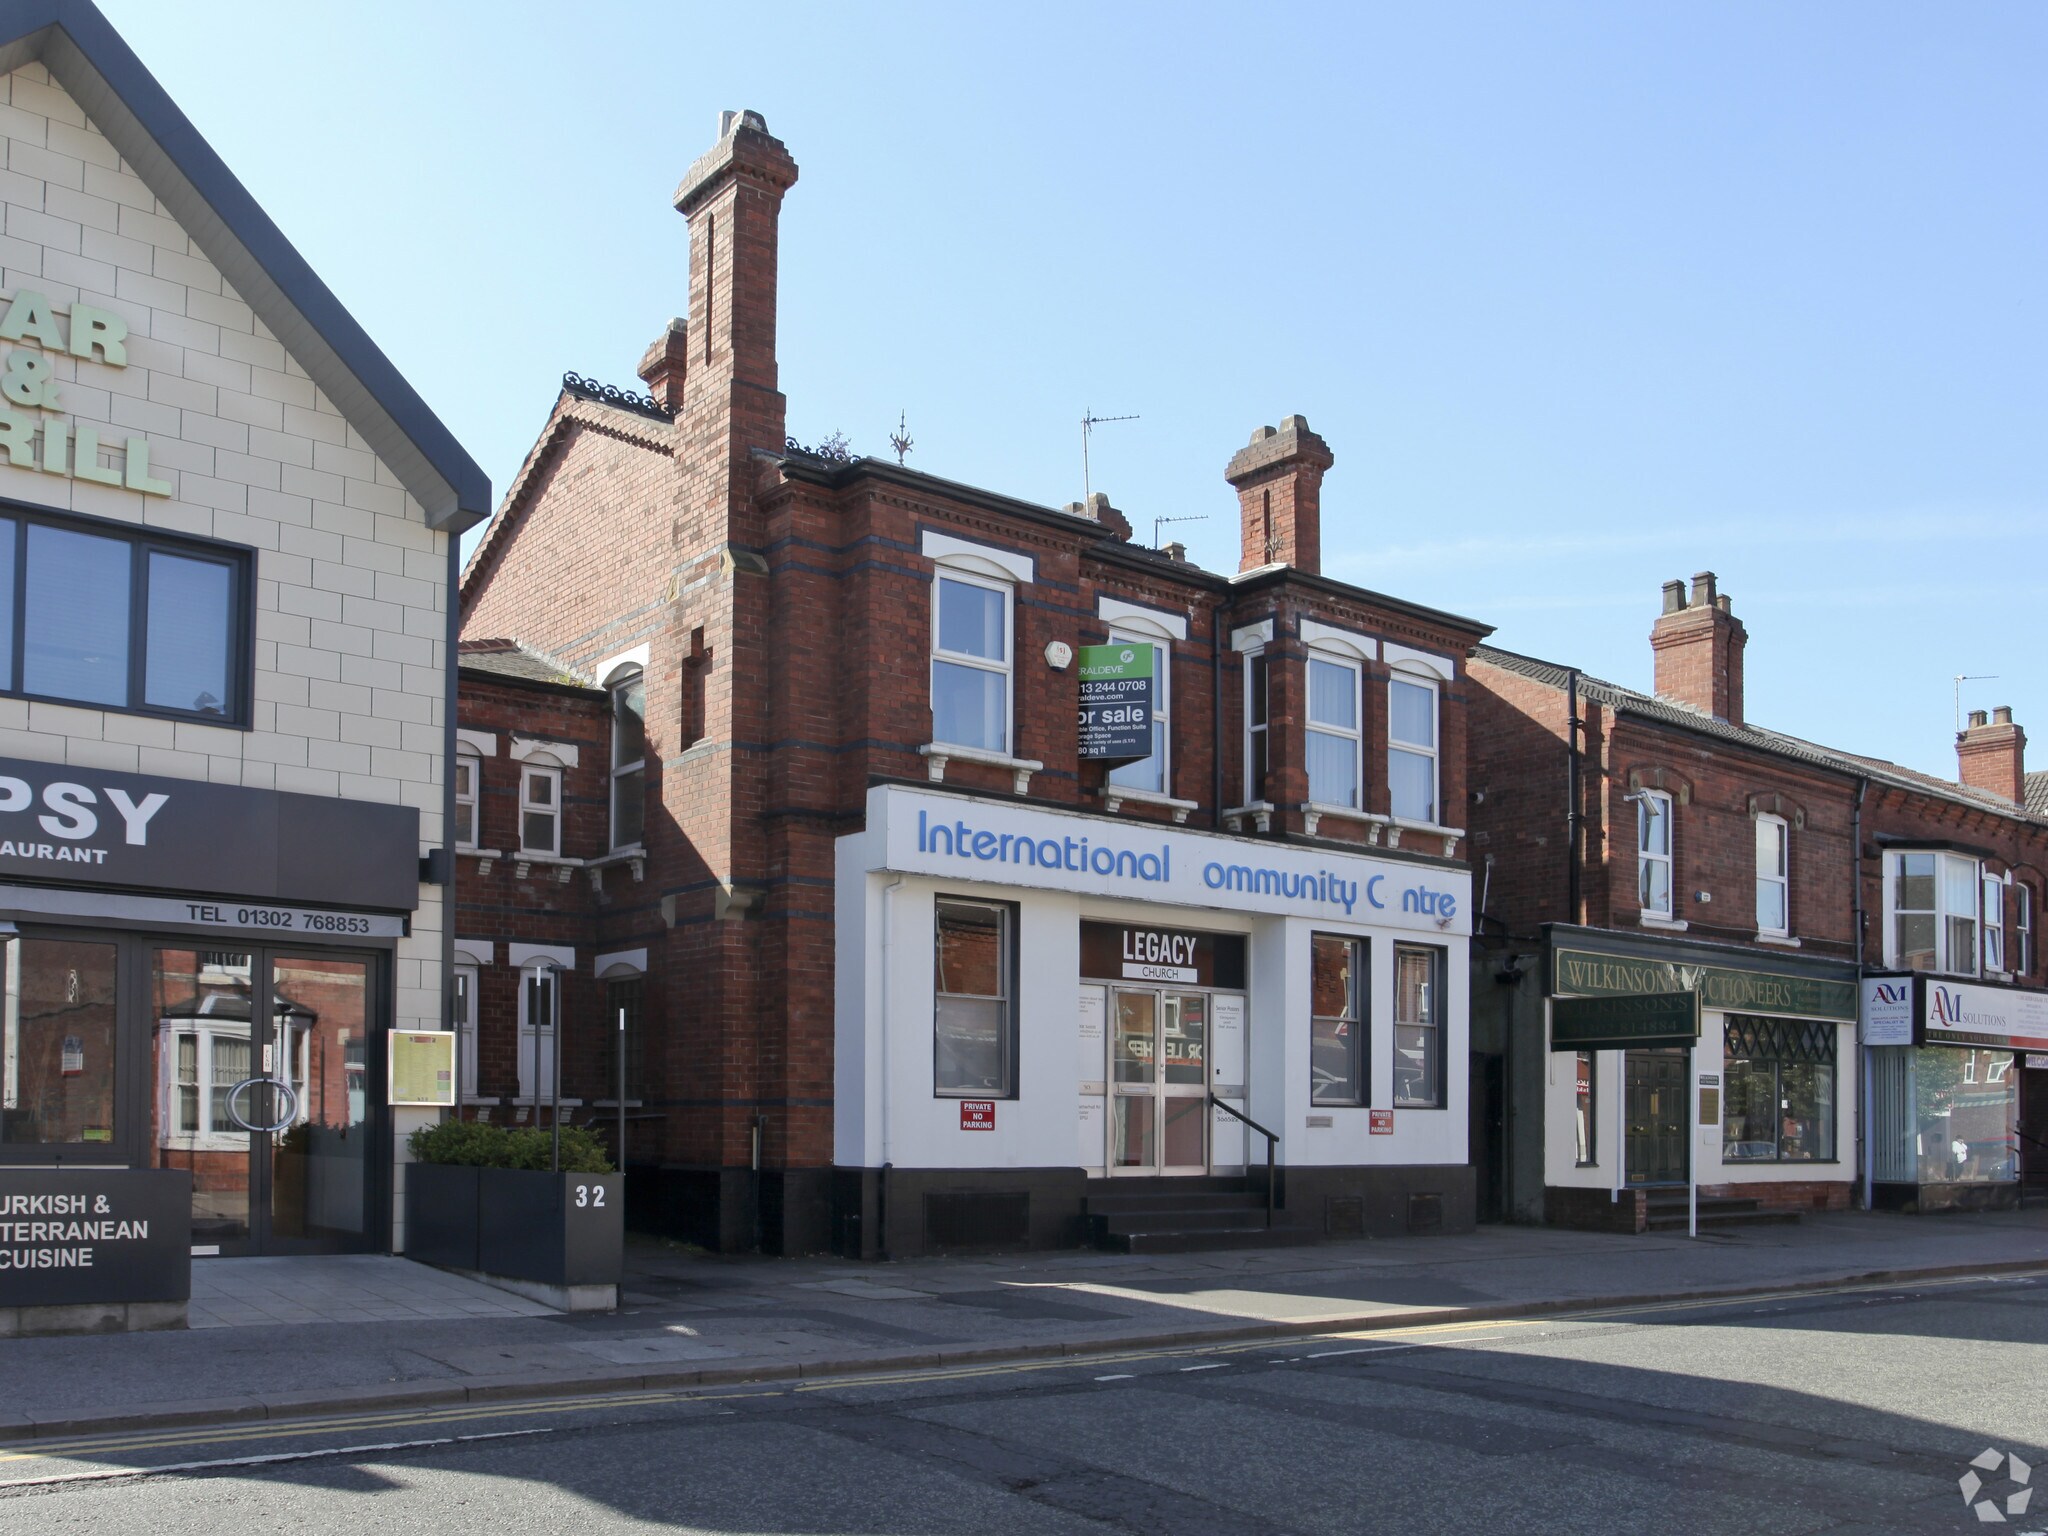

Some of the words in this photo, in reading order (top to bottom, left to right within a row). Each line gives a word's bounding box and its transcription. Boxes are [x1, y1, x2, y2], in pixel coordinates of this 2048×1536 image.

[0, 288, 128, 368] AR
[1, 349, 65, 414] &
[1079, 683, 1093, 693] 13
[1095, 682, 1116, 693] 244
[1118, 680, 1146, 692] 0708
[1101, 705, 1144, 724] sale
[1094, 732, 1112, 740] Space
[1089, 747, 1099, 755] sq
[1100, 745, 1107, 754] ft
[0, 841, 109, 865] AURANT
[918, 809, 1170, 882] International
[1203, 861, 1357, 915] ommunity
[185, 904, 227, 922] TEL
[237, 908, 293, 928] 01302
[302, 913, 370, 934] 768853
[1123, 930, 1197, 965] LEGACY
[1142, 966, 1179, 980] CHURCH
[1871, 983, 1907, 1005] AM
[1930, 985, 1962, 1028] AM
[1962, 1012, 2007, 1028] SOLUTIONS
[964, 1102, 992, 1111] PRIVATE
[972, 1112, 983, 1120] NO
[962, 1121, 993, 1129] PARKING
[93, 1194, 111, 1214] &
[0, 1220, 148, 1242] TERRANEAN
[0, 1247, 93, 1269] CUISINE
